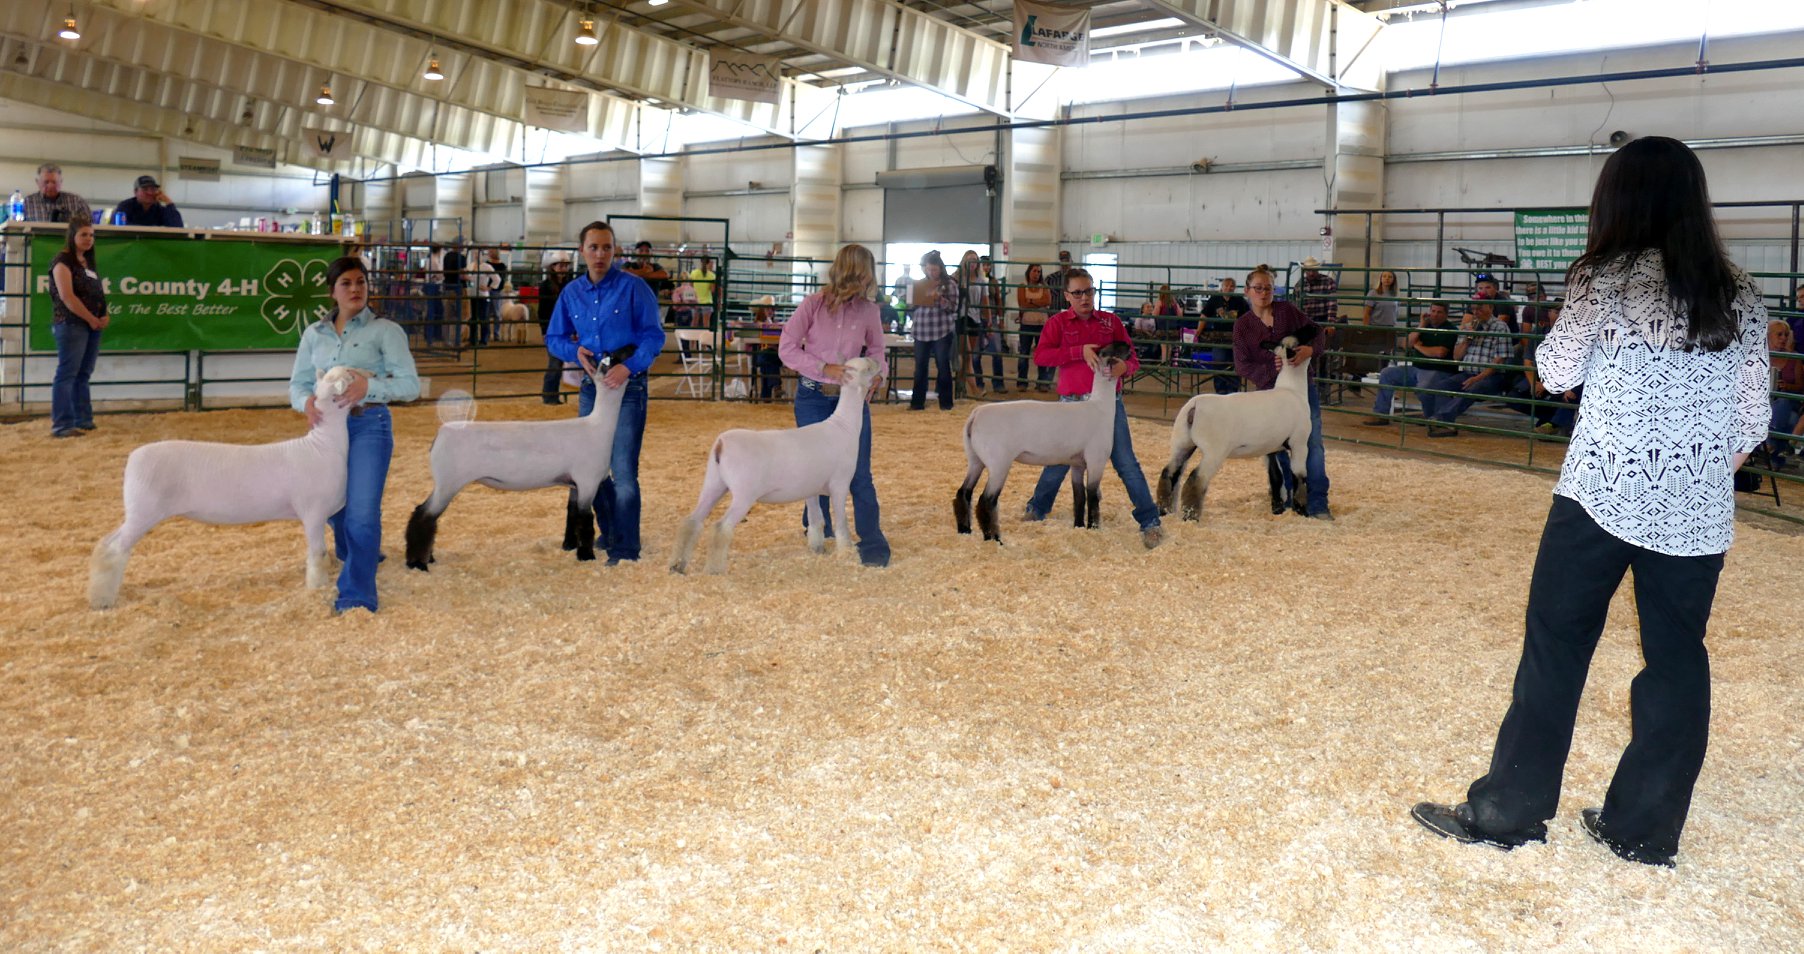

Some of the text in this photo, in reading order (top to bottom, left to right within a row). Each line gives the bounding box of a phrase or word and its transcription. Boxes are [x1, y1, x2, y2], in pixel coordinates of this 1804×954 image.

[317, 135, 336, 153] W
[1523, 214, 1564, 223] Somewhere
[1566, 214, 1574, 223] in
[1516, 226, 1533, 234] there
[1534, 226, 1542, 234] is
[1548, 226, 1566, 234] little
[1566, 226, 1579, 234] kid
[1517, 238, 1525, 246] to
[1525, 238, 1534, 246] be
[1535, 238, 1549, 247] just
[1549, 238, 1564, 246] like
[1564, 238, 1578, 247] you
[1518, 249, 1531, 257] You
[1546, 249, 1553, 257] it
[1553, 249, 1561, 257] to
[1561, 249, 1581, 257] them
[1536, 260, 1552, 269] BEST
[1553, 261, 1567, 269] you
[119, 275, 211, 299] County
[217, 278, 259, 296] 4-H
[129, 303, 151, 315] The
[156, 303, 190, 315] Best
[192, 303, 239, 316] Better
